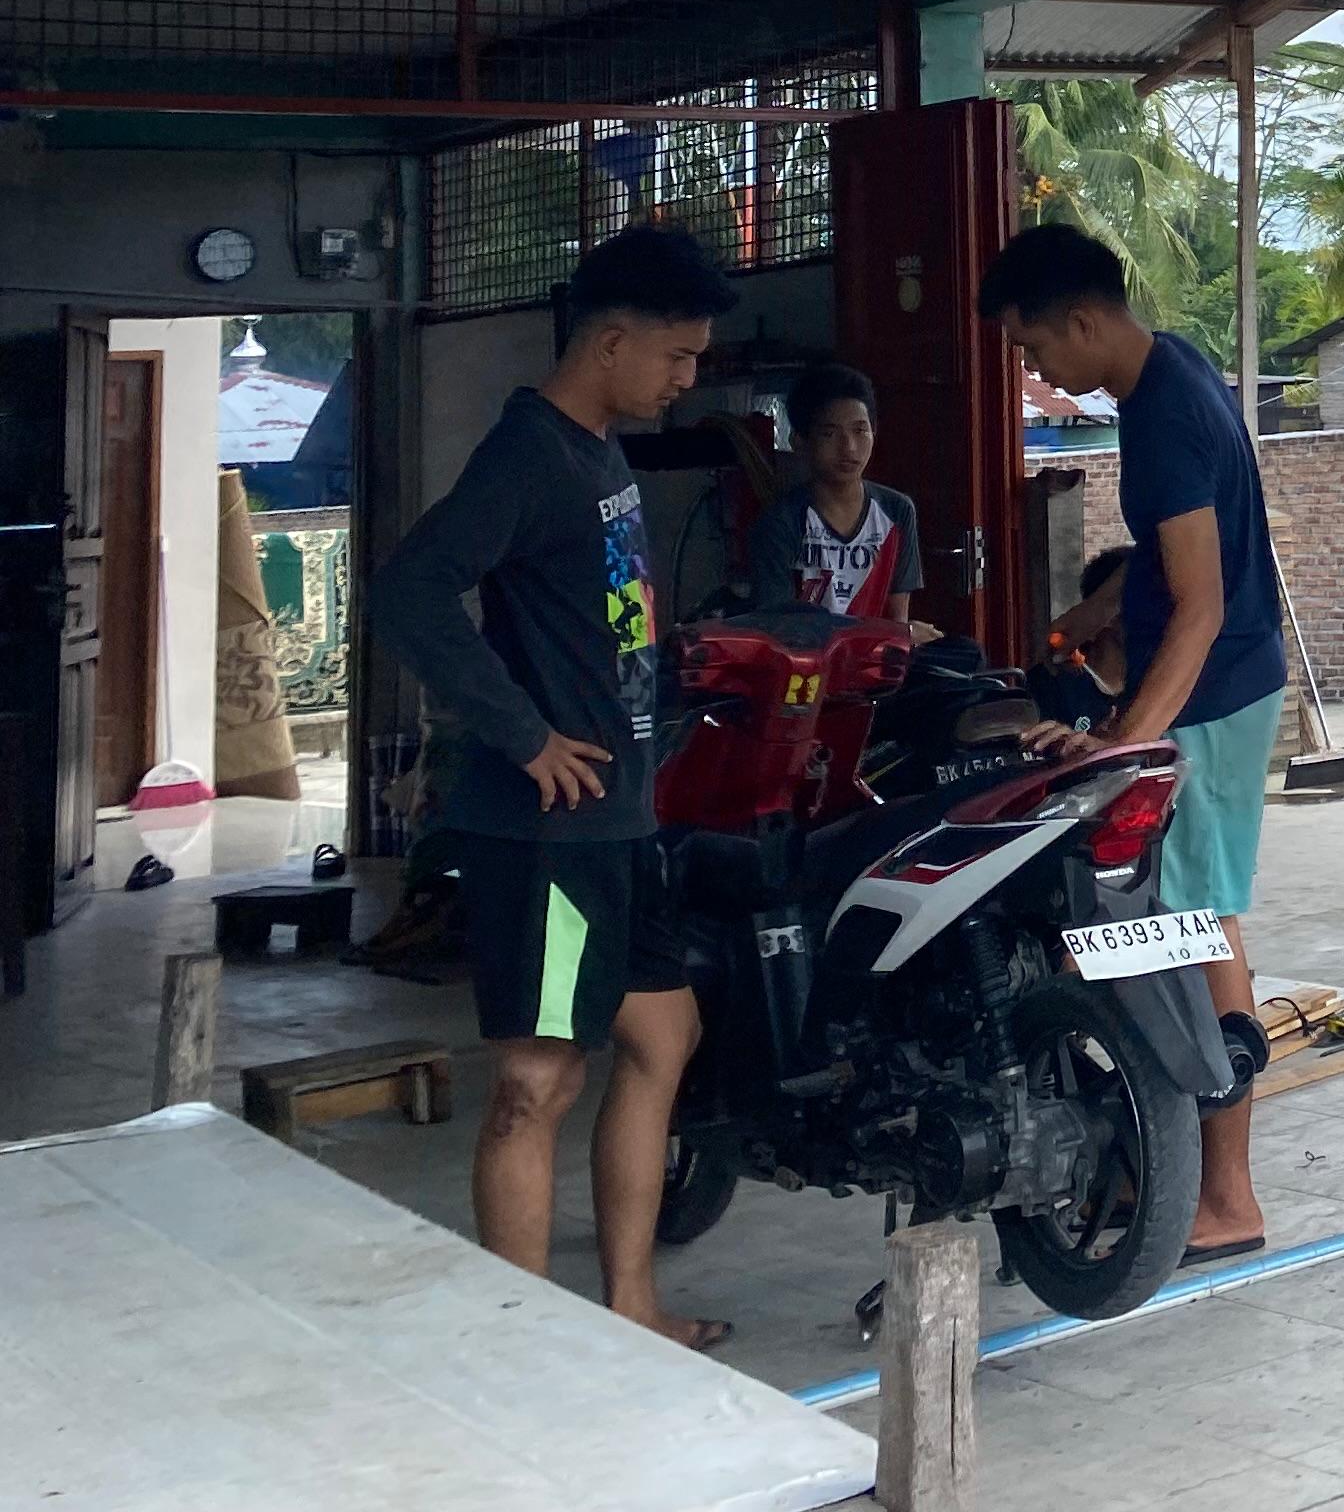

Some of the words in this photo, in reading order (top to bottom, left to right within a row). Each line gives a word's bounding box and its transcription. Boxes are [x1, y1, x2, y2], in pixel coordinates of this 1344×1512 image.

[1095, 867, 1134, 879] HONDA
[1067, 931, 1100, 955] BK
[1102, 920, 1164, 950] 6393
[1173, 912, 1221, 937] XAH
[1168, 948, 1191, 962] 10
[1208, 943, 1229, 956] 26
